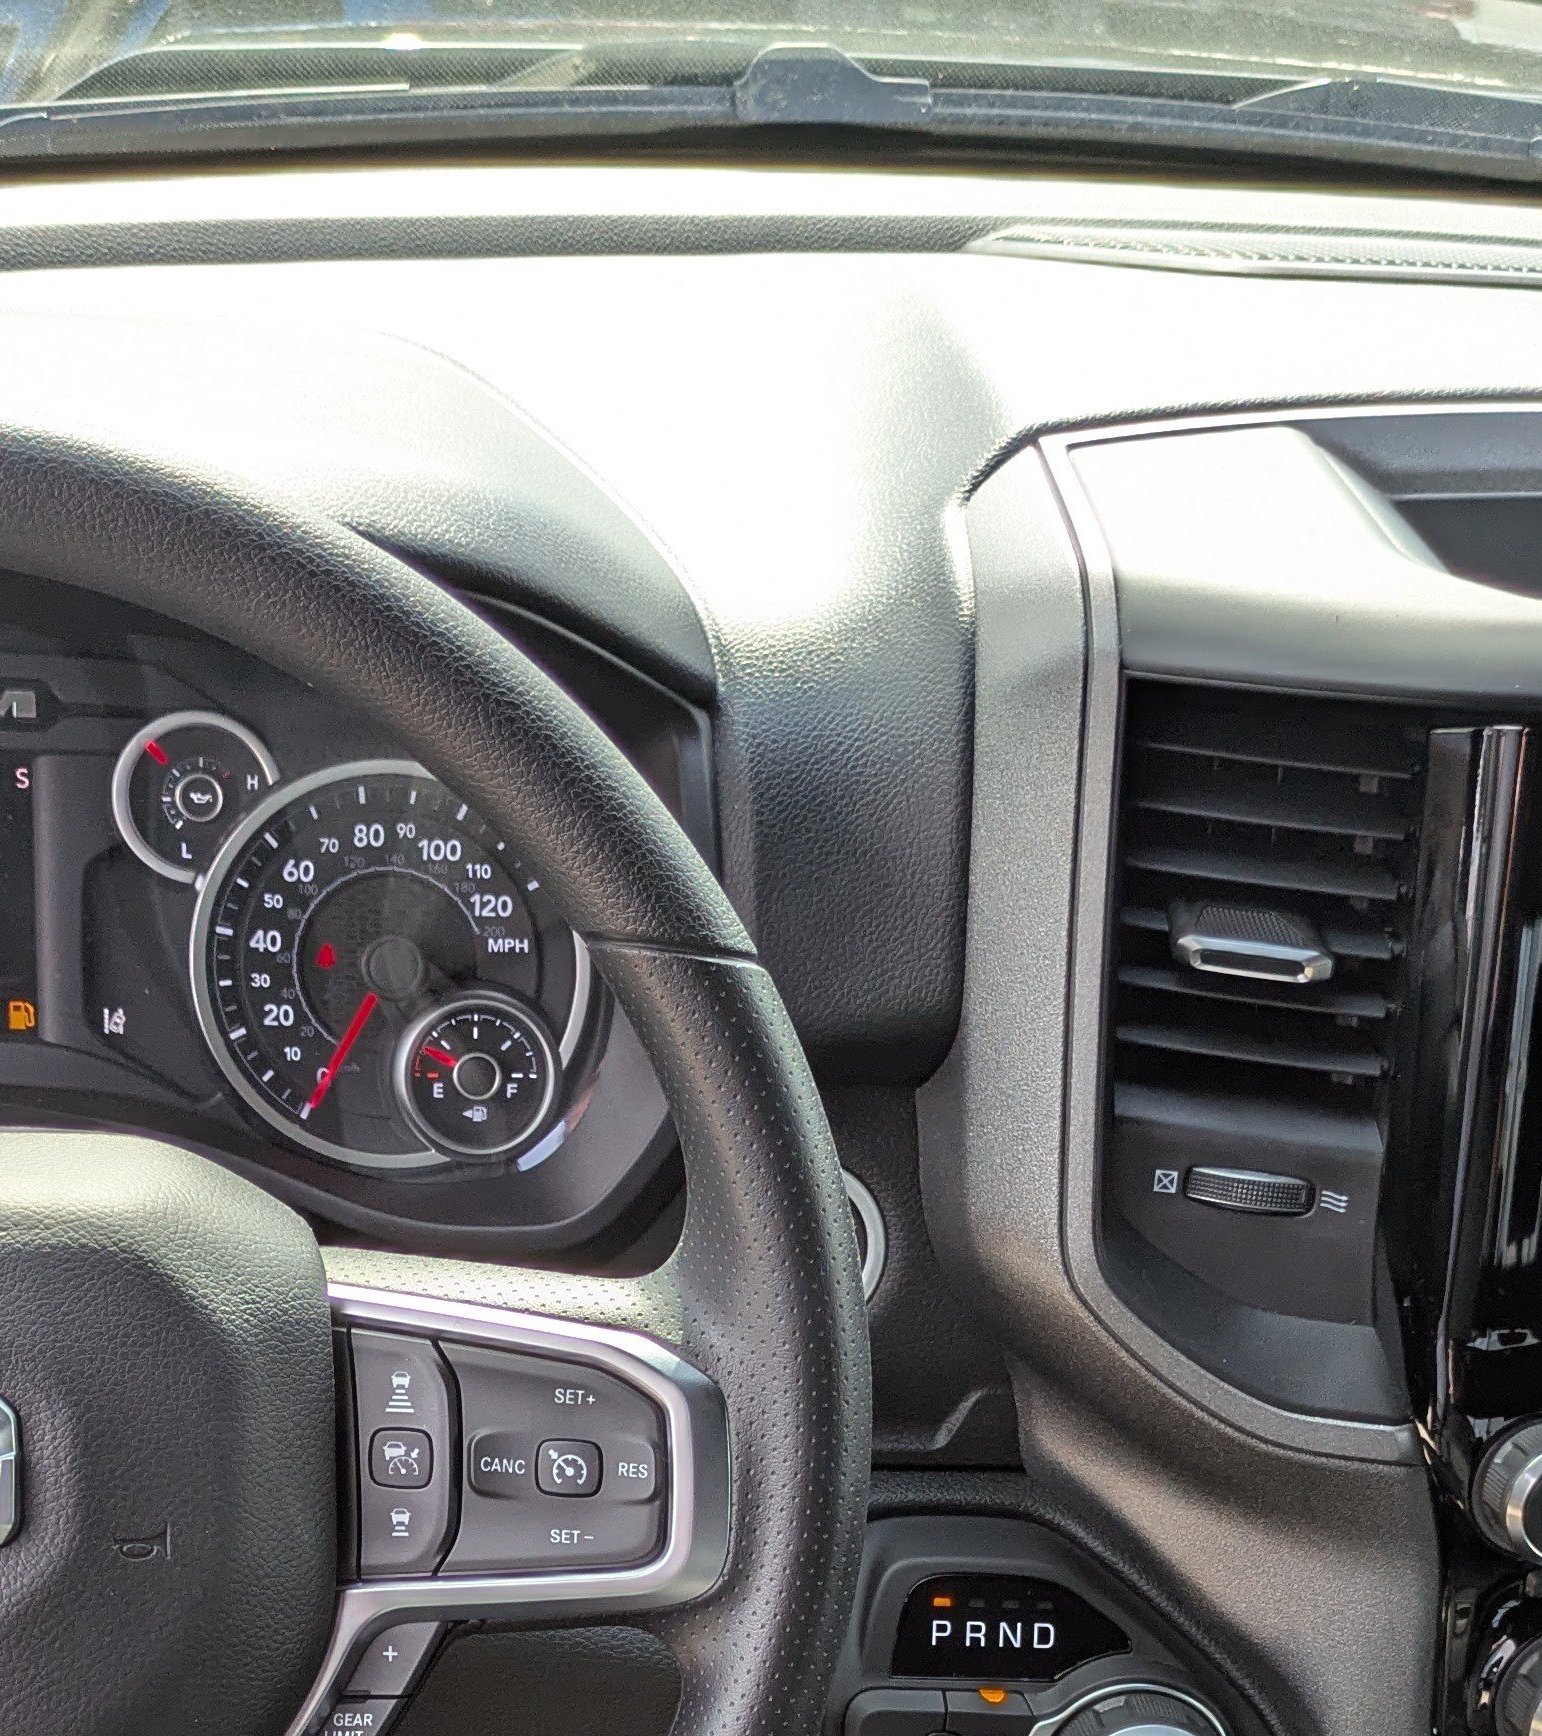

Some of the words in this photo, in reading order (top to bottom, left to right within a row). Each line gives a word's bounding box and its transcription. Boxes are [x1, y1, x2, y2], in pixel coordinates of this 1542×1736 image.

[15, 768, 29, 788] S
[247, 775, 258, 791] H
[354, 824, 385, 847] 80
[396, 823, 416, 838] 90
[320, 838, 339, 853] 70
[418, 839, 461, 861] 100
[283, 859, 314, 882] 60
[465, 864, 491, 879] 110
[264, 894, 283, 909] 50
[470, 894, 513, 917] 120
[249, 930, 282, 953] 40
[488, 939, 529, 953] MPH
[251, 973, 270, 988] 30
[263, 1004, 294, 1026] 20
[284, 1047, 301, 1061] 10
[434, 1083, 444, 1099] E
[507, 1084, 518, 1099] F
[481, 1457, 525, 1474] CANC
[618, 1463, 648, 1478] RES
[333, 1714, 373, 1726] GEAR
